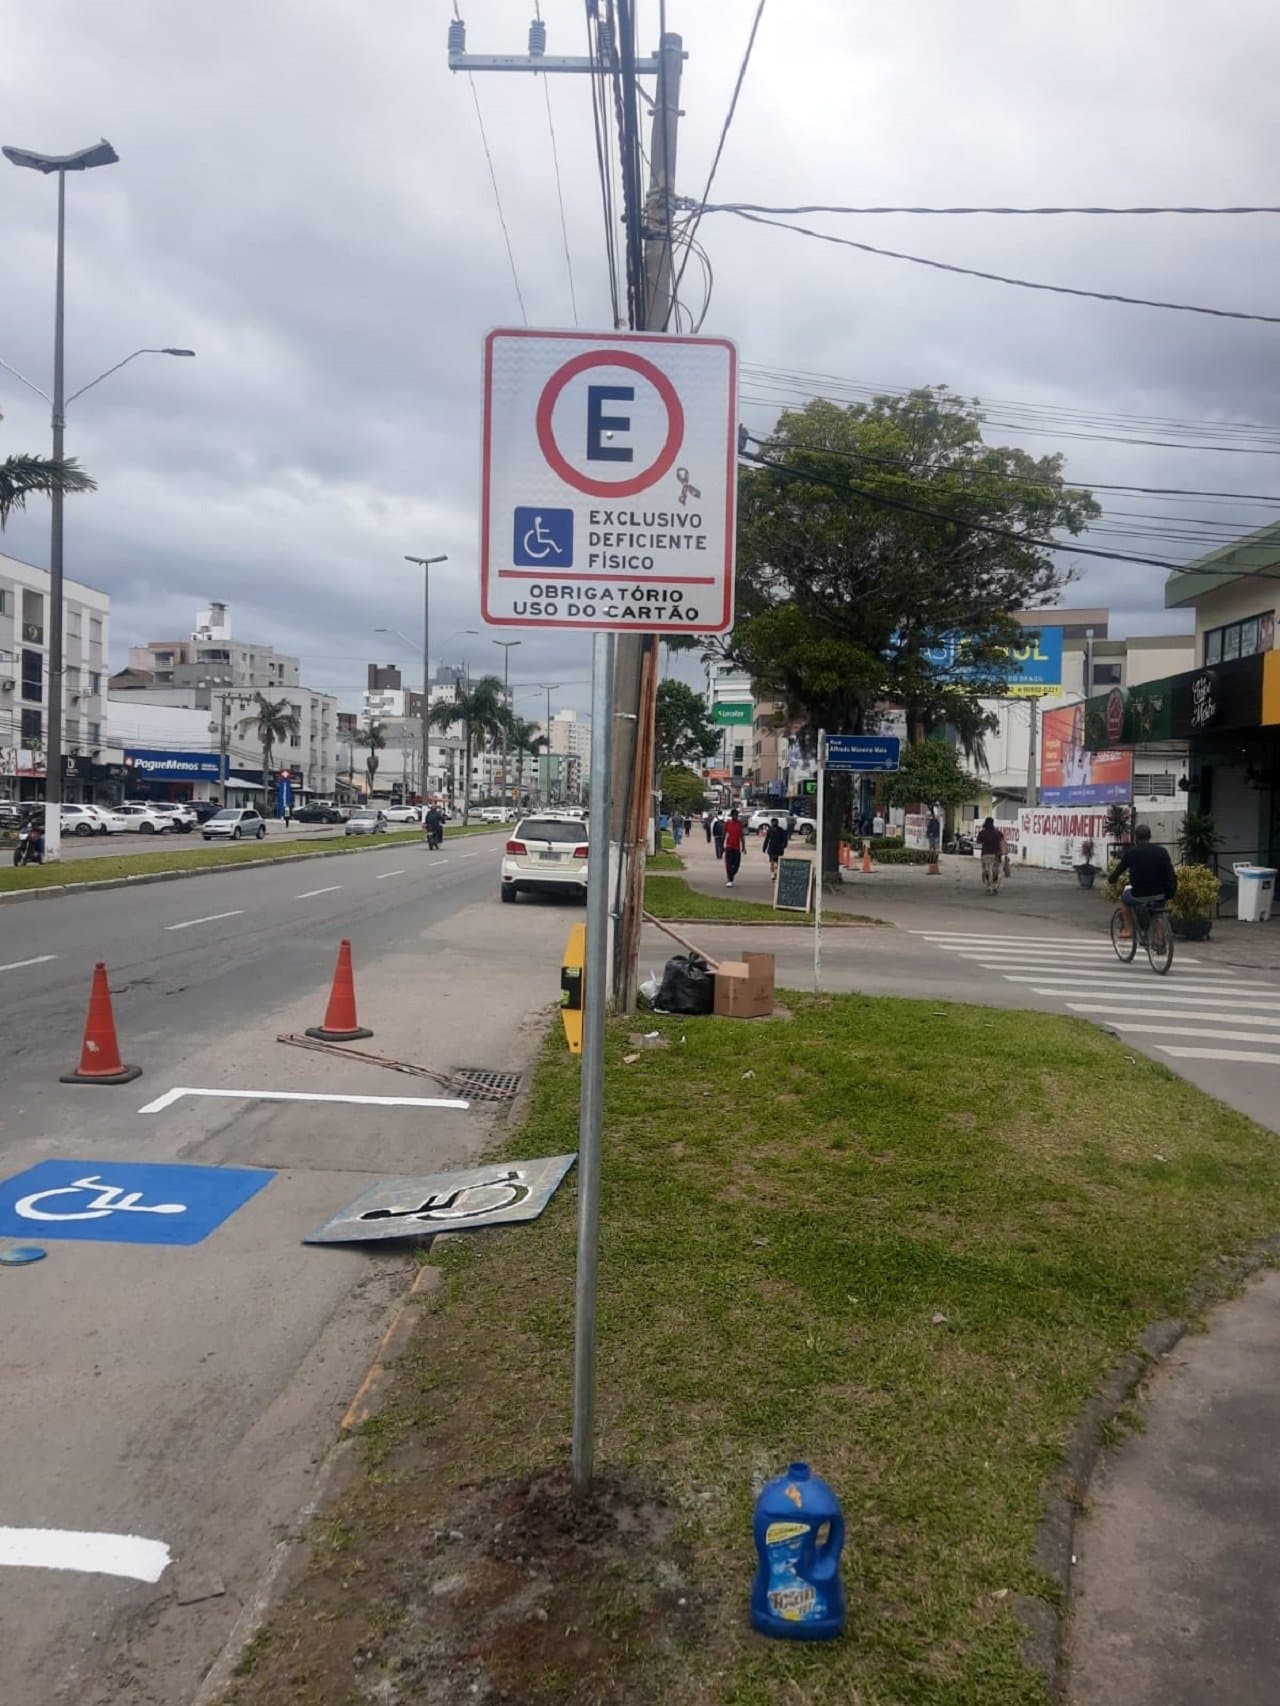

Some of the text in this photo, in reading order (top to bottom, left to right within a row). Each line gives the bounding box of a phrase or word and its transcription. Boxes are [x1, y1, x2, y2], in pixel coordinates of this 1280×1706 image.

[587, 385, 634, 462] E
[589, 511, 702, 528] EXCLUSIVO
[589, 532, 707, 550] DEFICIENTE
[588, 551, 654, 570] FÍSICO
[530, 584, 683, 603] OBRIGATÓRIO
[514, 602, 699, 621] USO DO CARTÃO
